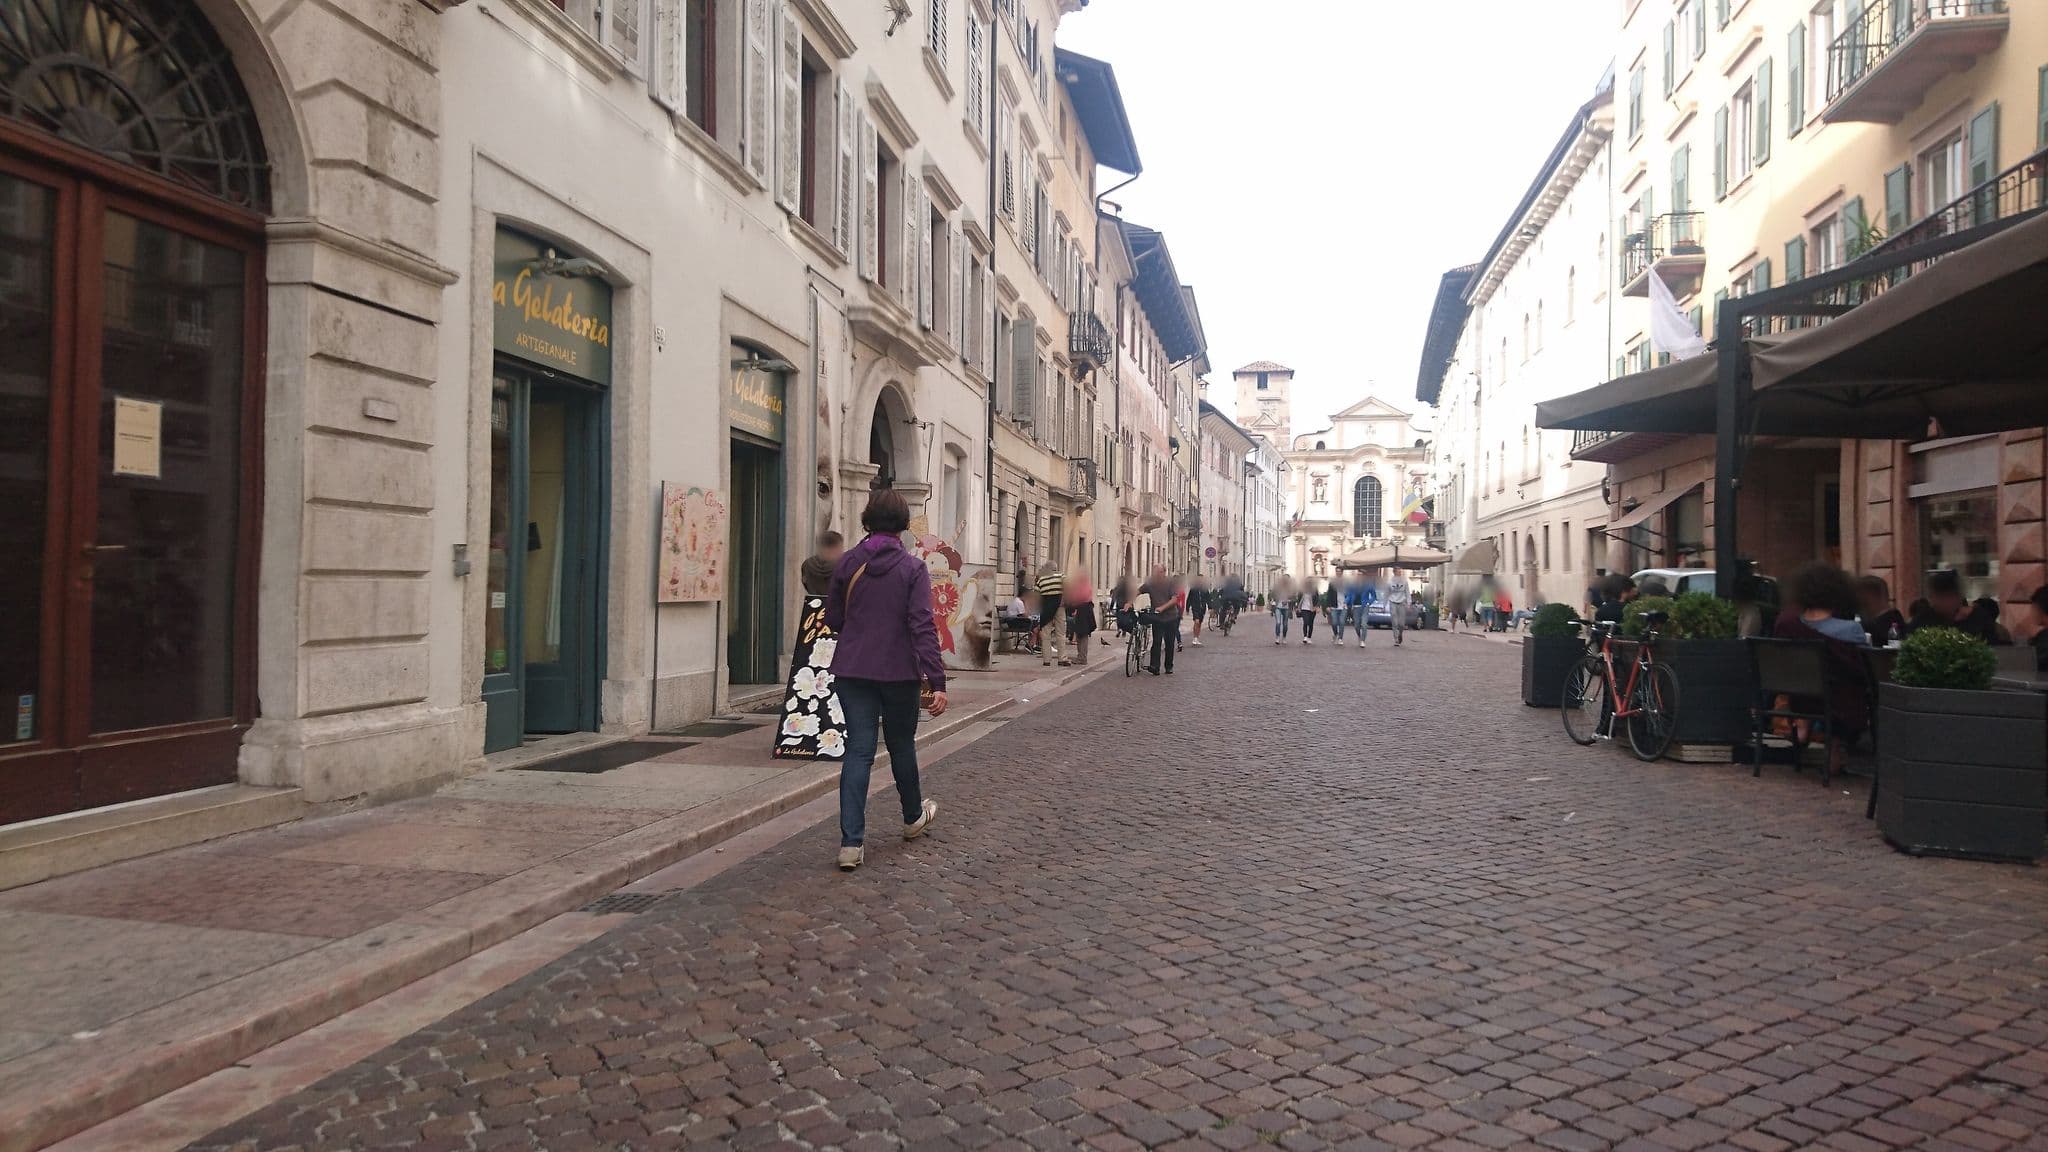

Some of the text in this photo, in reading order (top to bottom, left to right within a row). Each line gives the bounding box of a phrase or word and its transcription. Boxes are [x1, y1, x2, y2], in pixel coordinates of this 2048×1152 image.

[493, 268, 609, 346] a Gelateria
[516, 333, 578, 365] ARTIGIANALE
